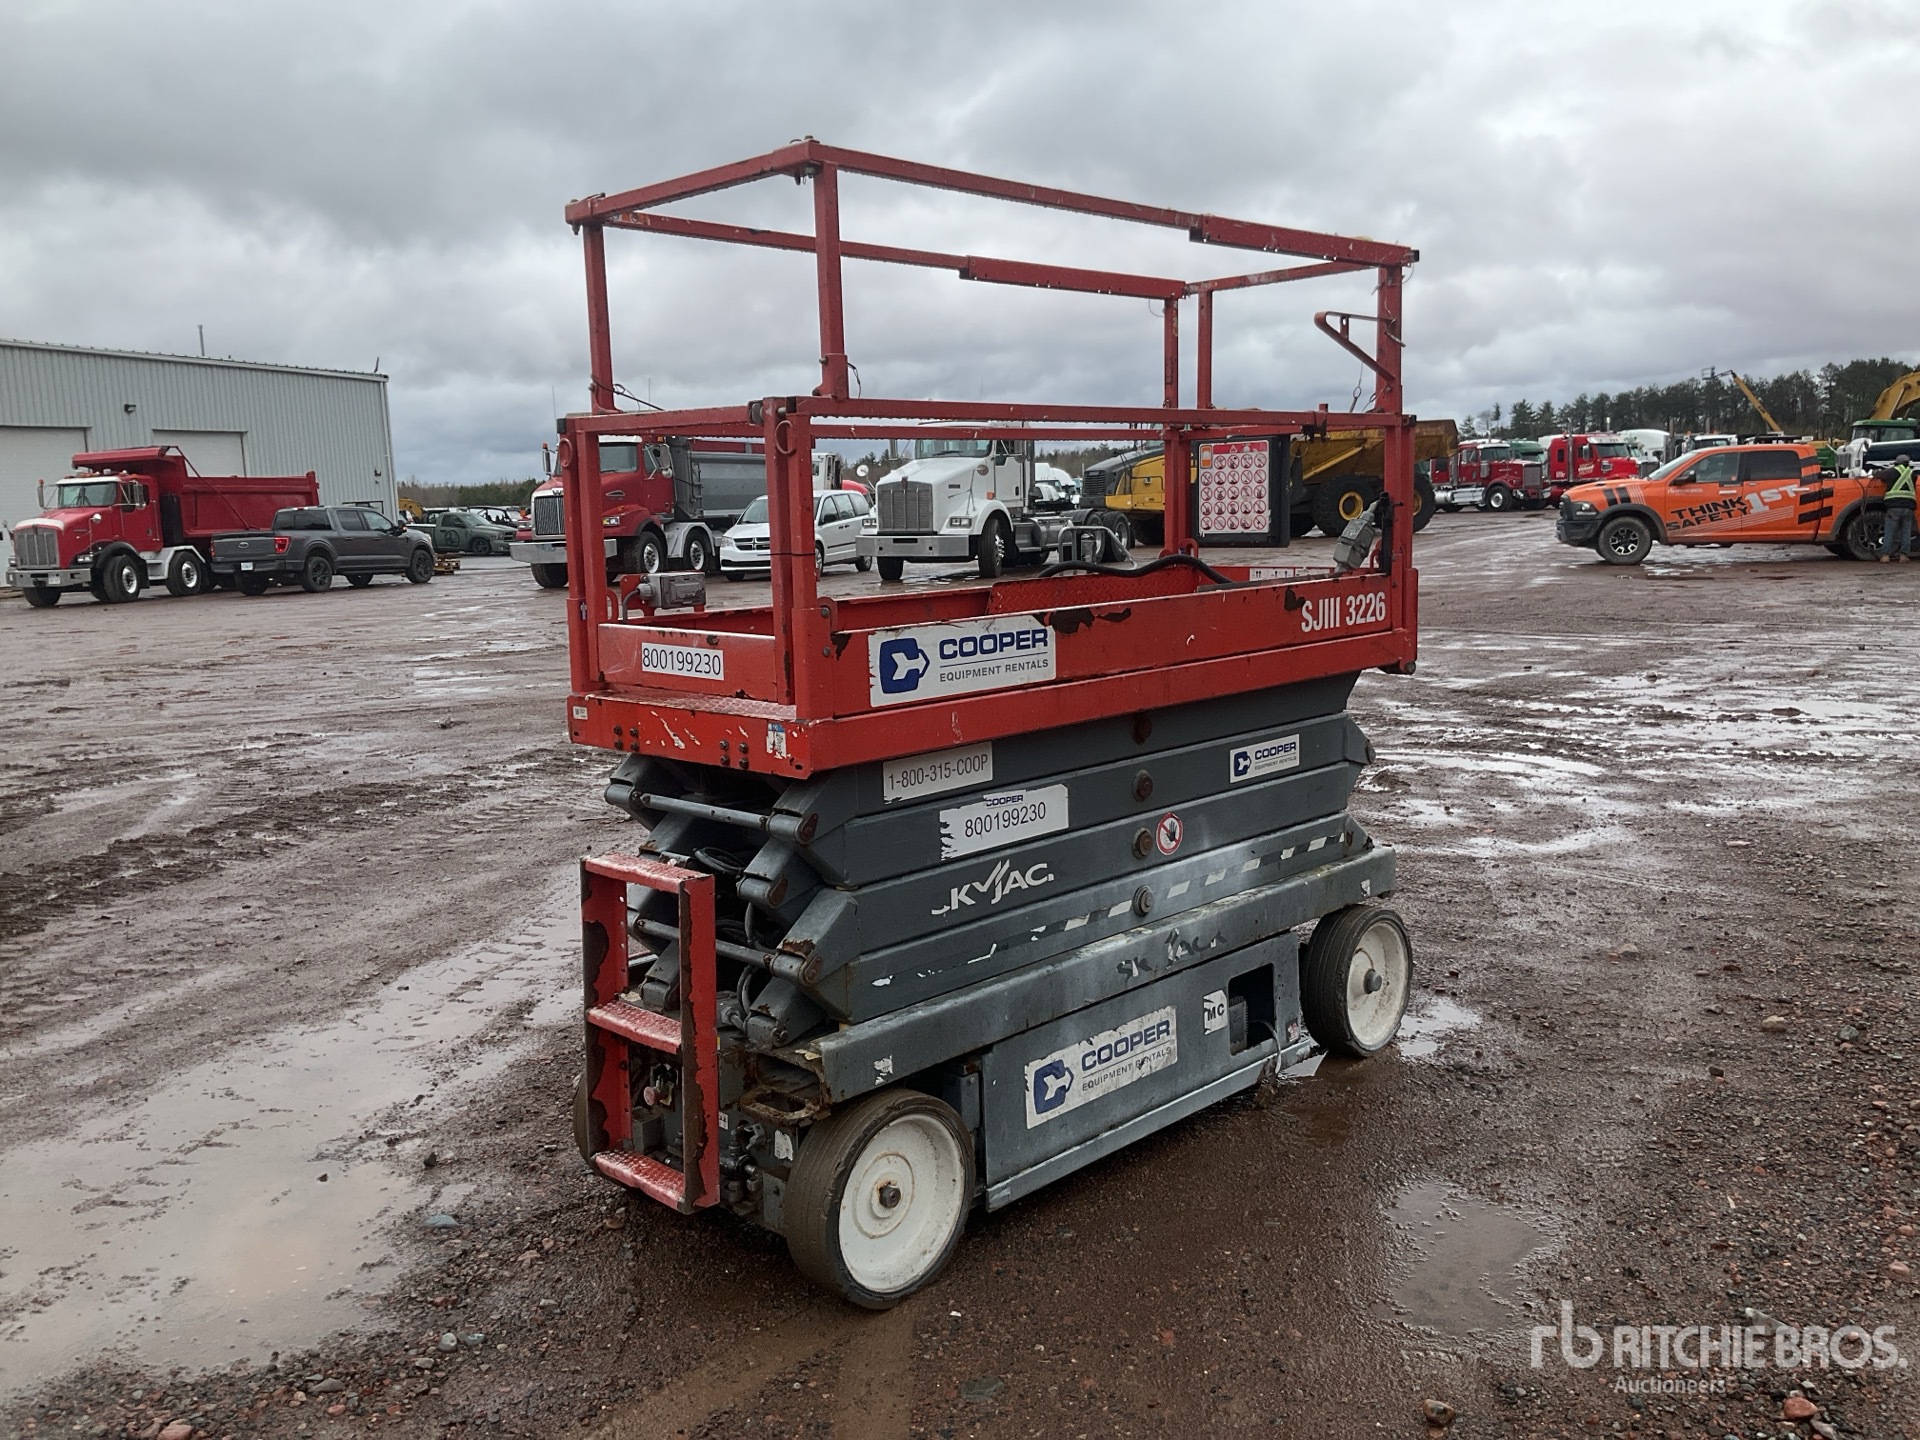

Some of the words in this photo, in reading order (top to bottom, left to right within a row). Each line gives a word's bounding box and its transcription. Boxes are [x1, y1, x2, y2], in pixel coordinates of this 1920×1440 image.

[1665, 507, 1748, 532] SAFETY
[1670, 496, 1746, 520] THINK
[1301, 596, 1341, 633] SJIII
[1345, 591, 1386, 626] 3226
[938, 628, 1048, 660] COOPER
[642, 647, 721, 676] 800199230
[939, 665, 1001, 682] EQUIPMENT
[1005, 659, 1049, 673] RENTALS
[1254, 741, 1297, 760] COOPER
[965, 801, 1046, 838] 800199230
[1081, 1019, 1171, 1072] COOPER
[1082, 1062, 1133, 1092] EQUIPMENT
